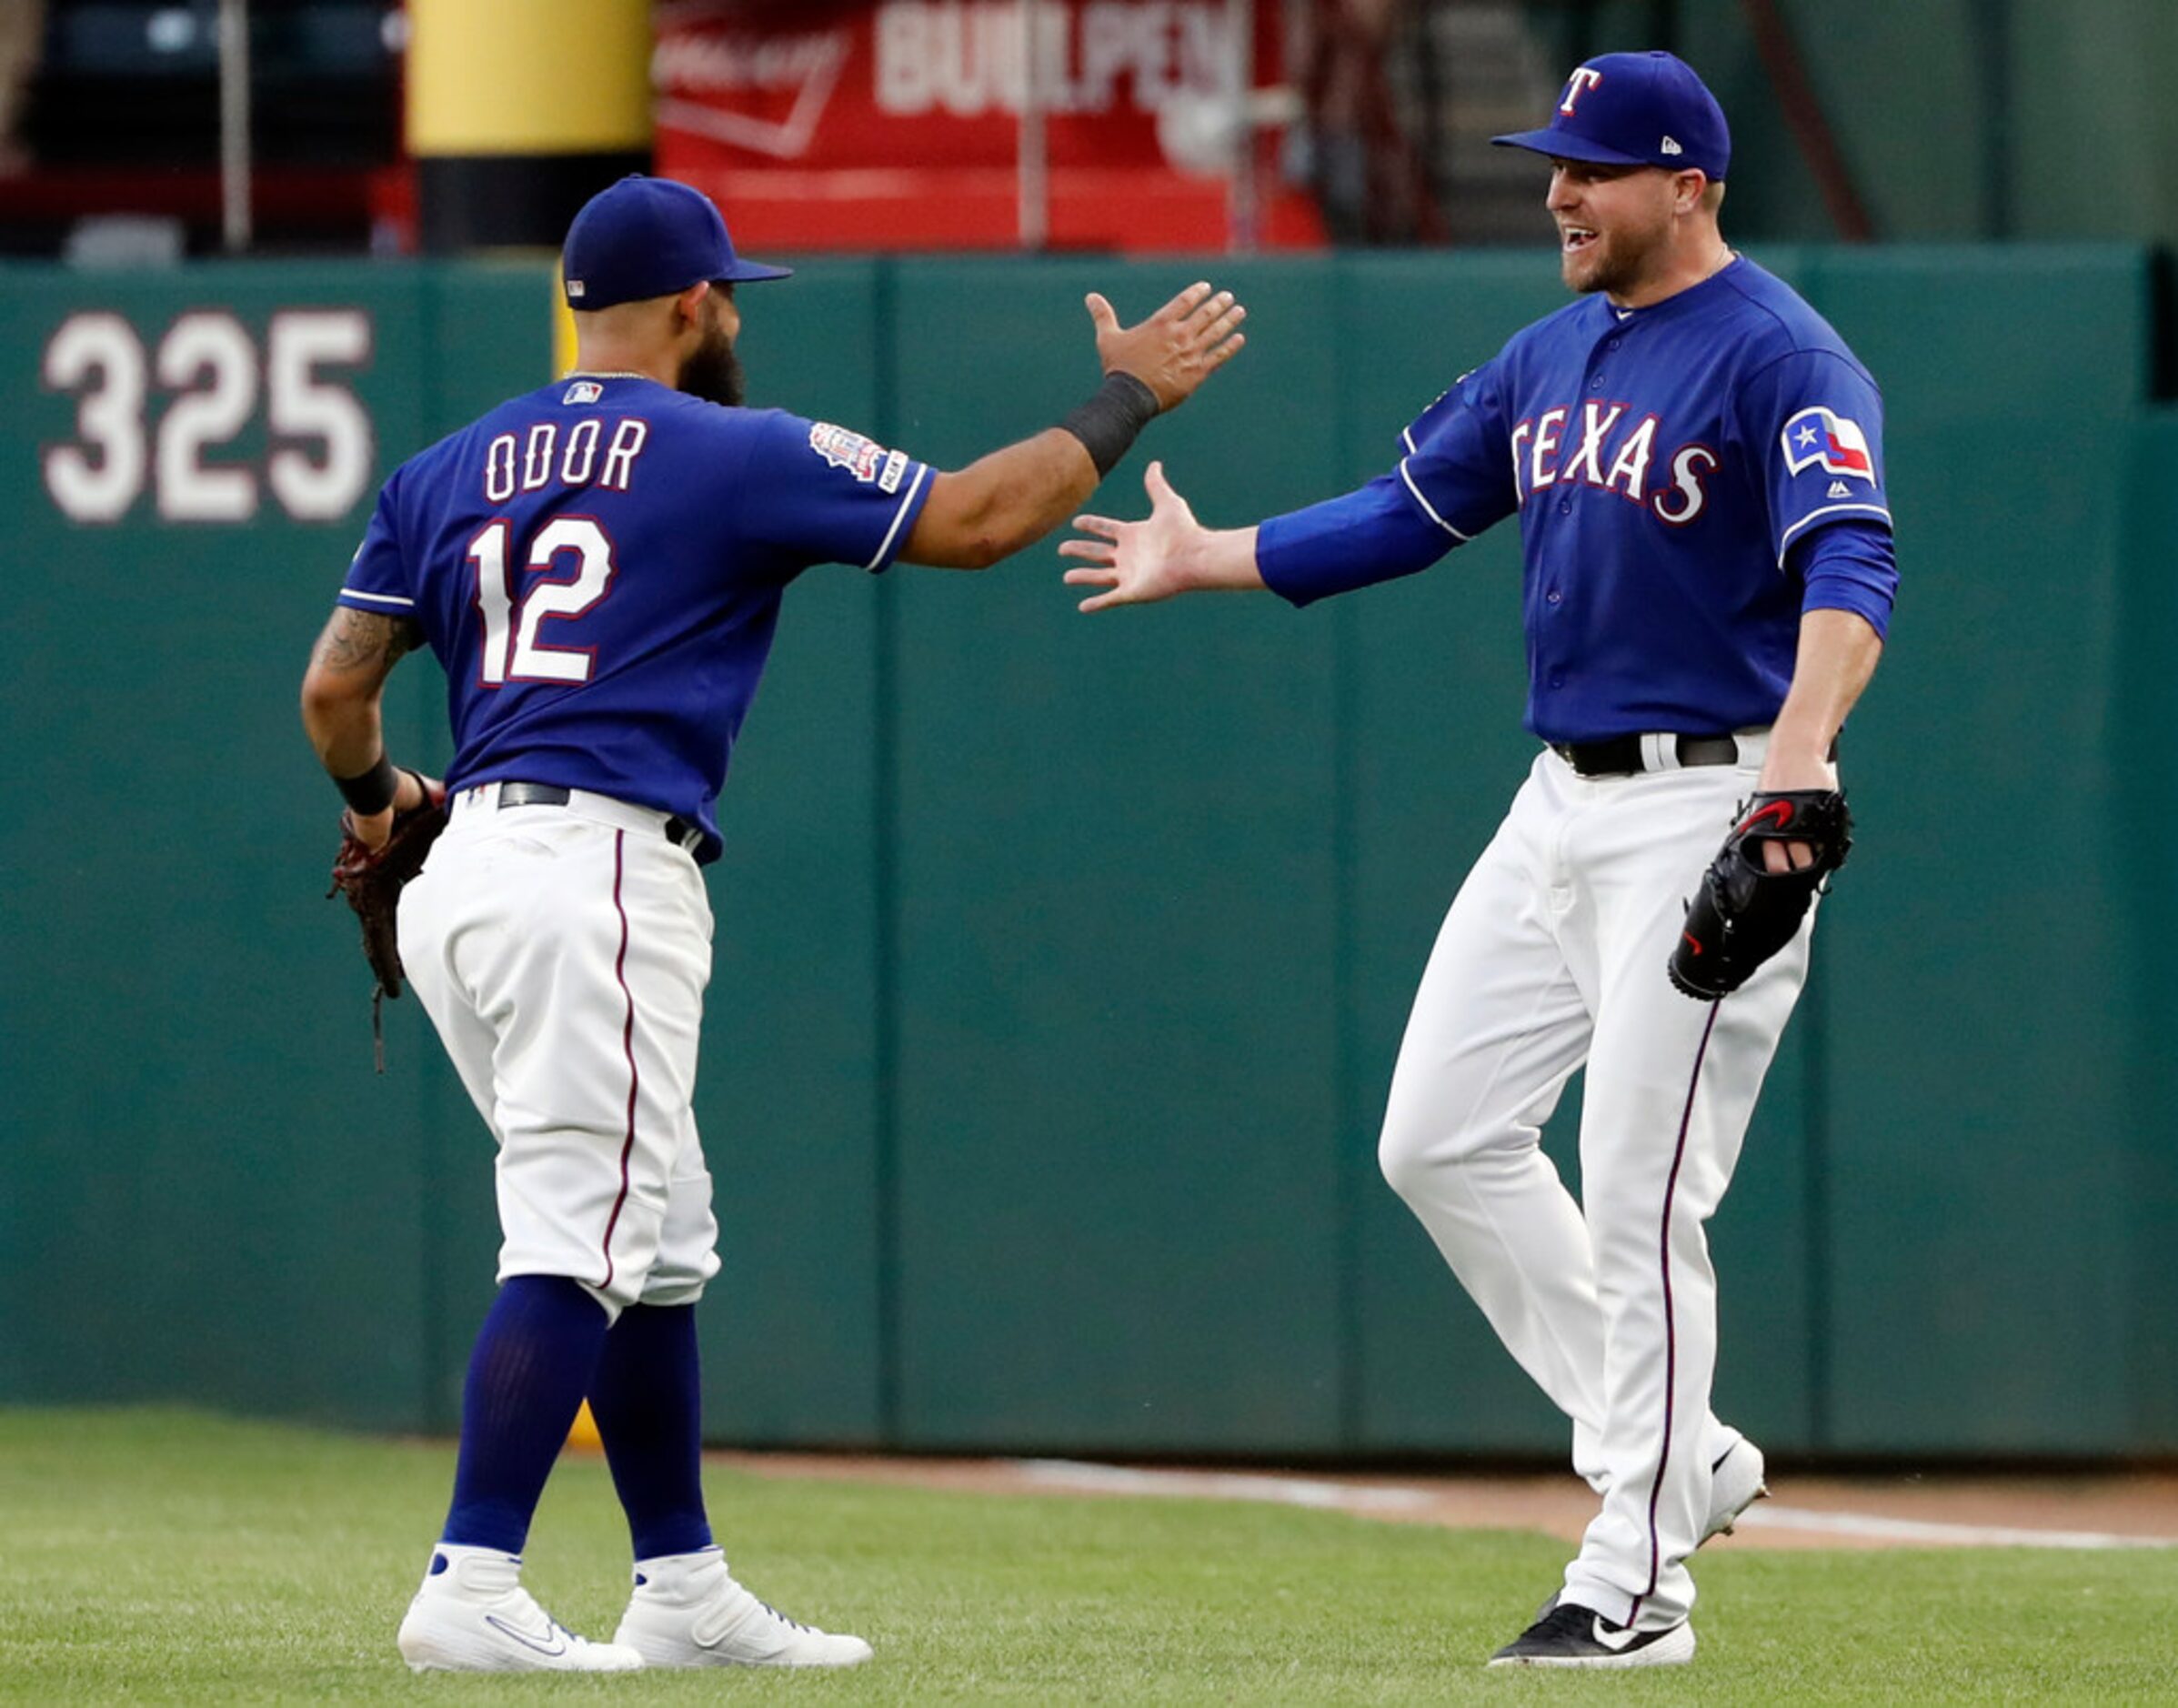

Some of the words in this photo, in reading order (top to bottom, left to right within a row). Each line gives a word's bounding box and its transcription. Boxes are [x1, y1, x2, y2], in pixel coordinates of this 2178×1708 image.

[1560, 66, 1602, 116] T
[42, 310, 374, 522] 325
[485, 418, 648, 504] ODOR
[466, 514, 619, 688] 12
